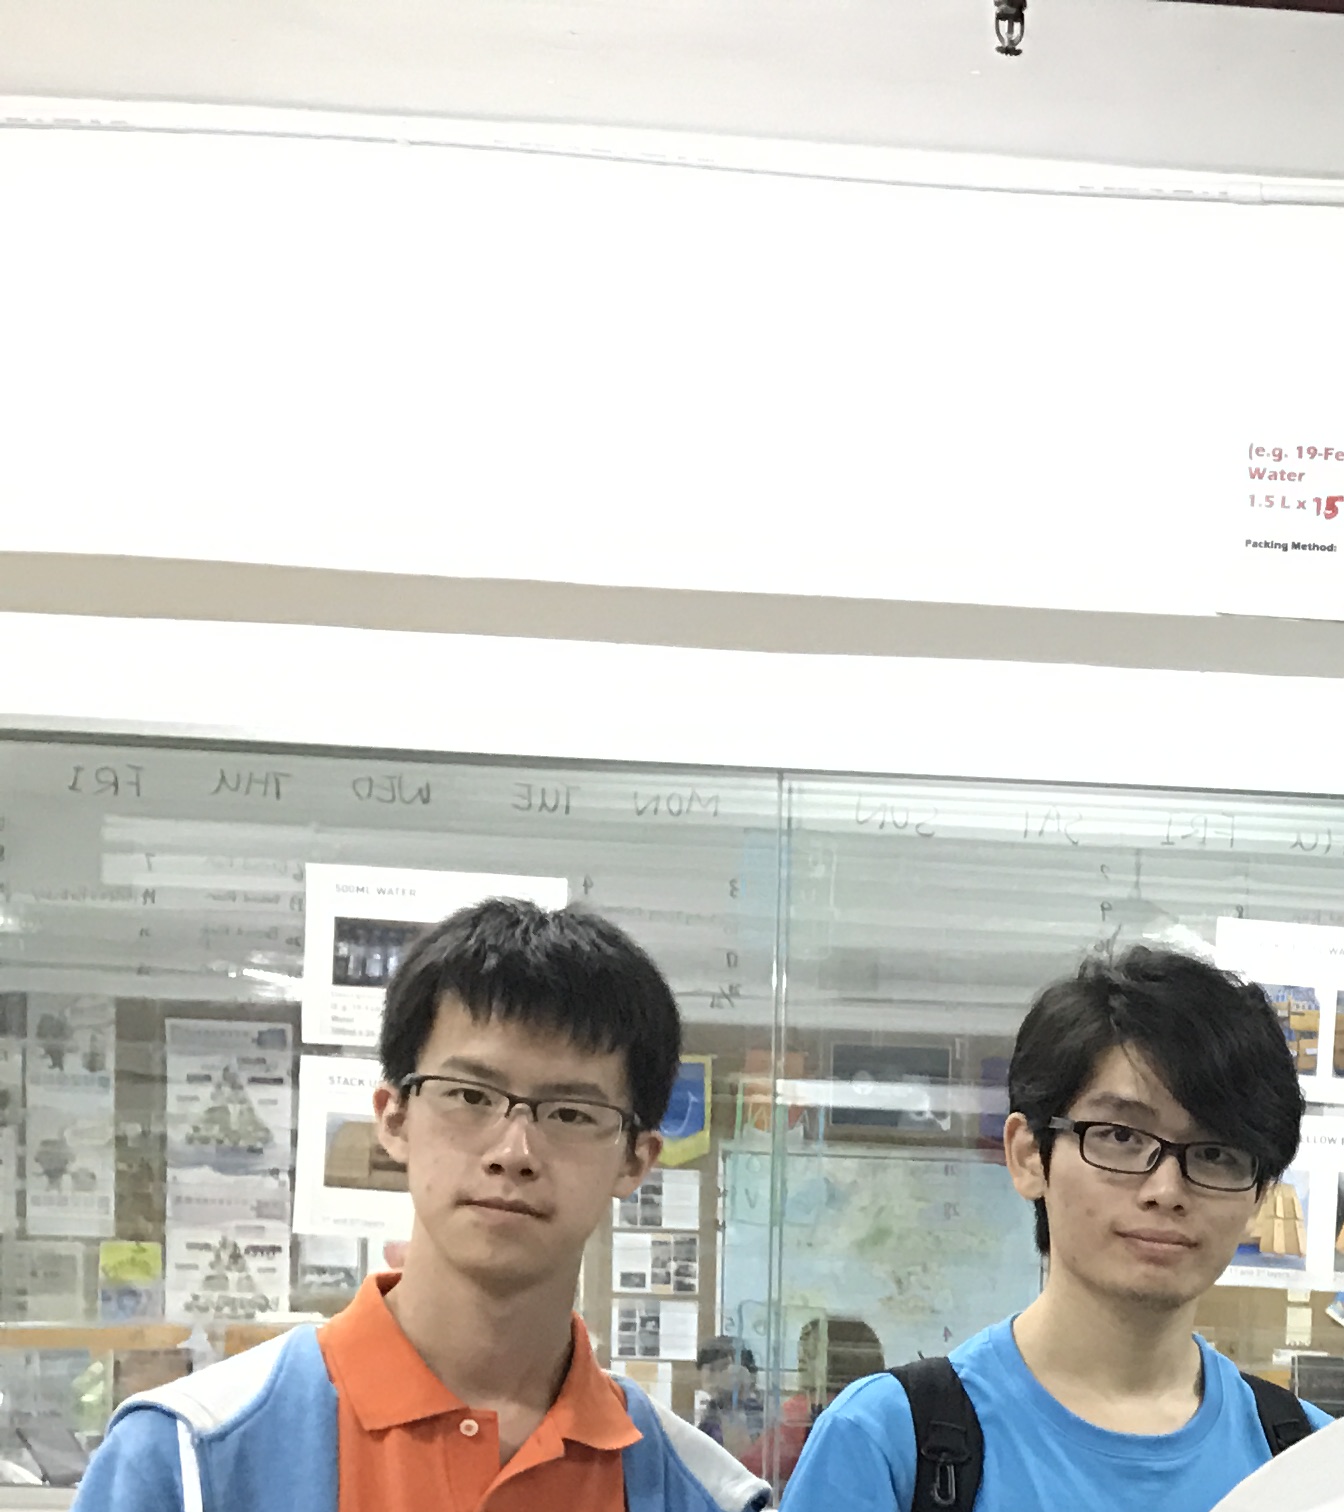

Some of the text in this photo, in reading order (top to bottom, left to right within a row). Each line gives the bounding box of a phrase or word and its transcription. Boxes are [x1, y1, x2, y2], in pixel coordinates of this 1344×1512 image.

[1248, 443, 1289, 463] (e.g.
[1248, 467, 1306, 483] Water
[1249, 493, 1275, 510] 1.5
[1280, 496, 1291, 510] L
[1245, 538, 1338, 553] Packing Method:
[376, 886, 417, 898] WATER
[328, 1075, 366, 1087] STACK
